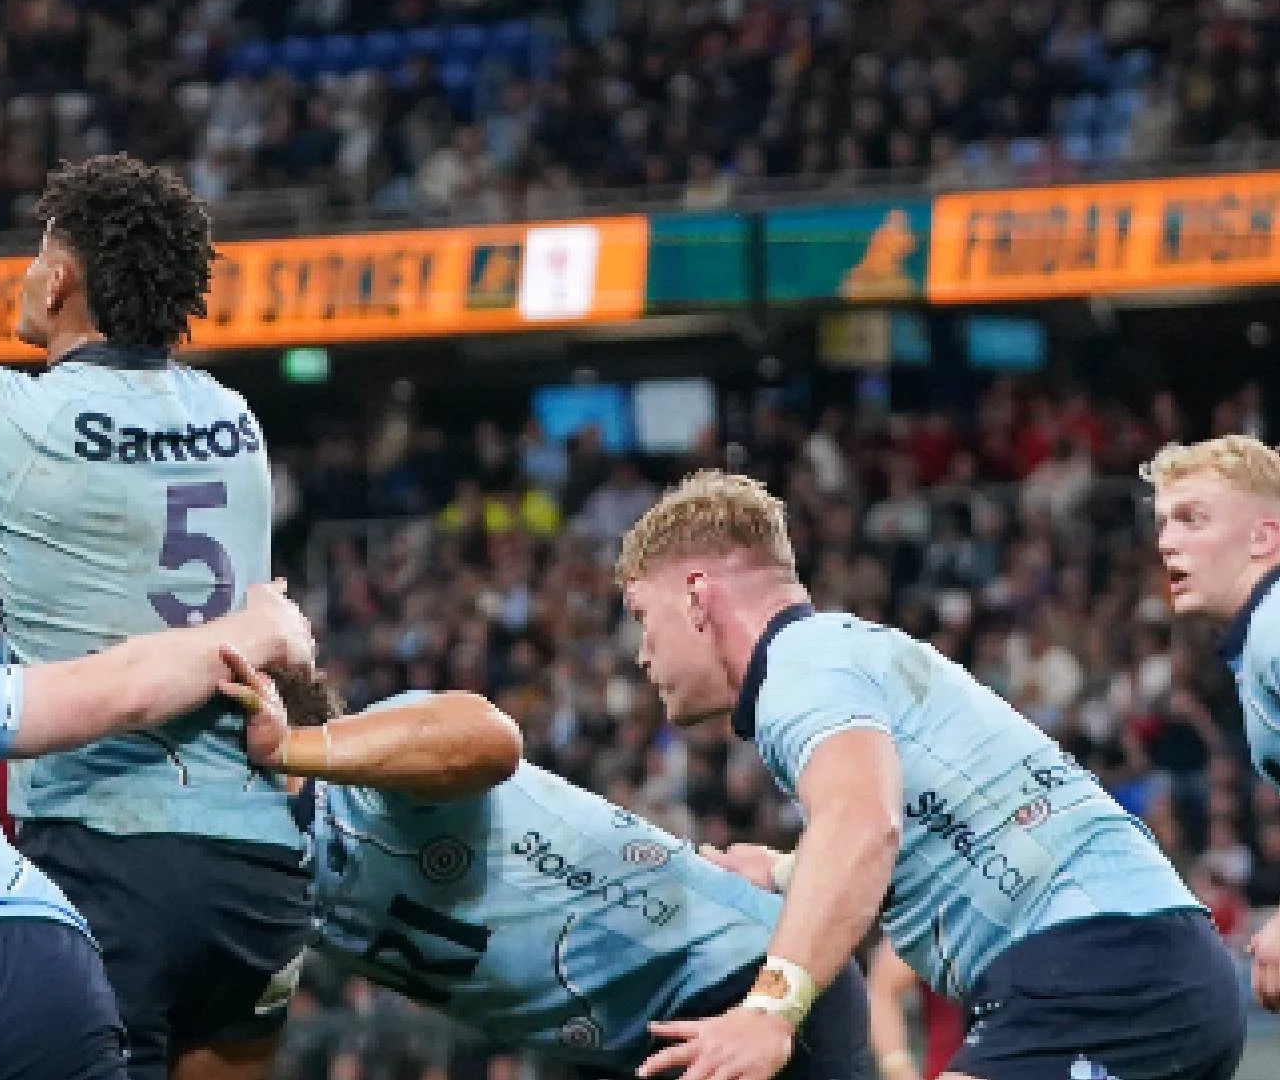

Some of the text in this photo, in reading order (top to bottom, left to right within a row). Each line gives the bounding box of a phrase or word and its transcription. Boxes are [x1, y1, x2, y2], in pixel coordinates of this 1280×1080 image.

[1160, 190, 1280, 266] NIGH
[266, 249, 433, 323] SYDNEY
[74, 411, 260, 464] Santos
[146, 481, 236, 629] 5
